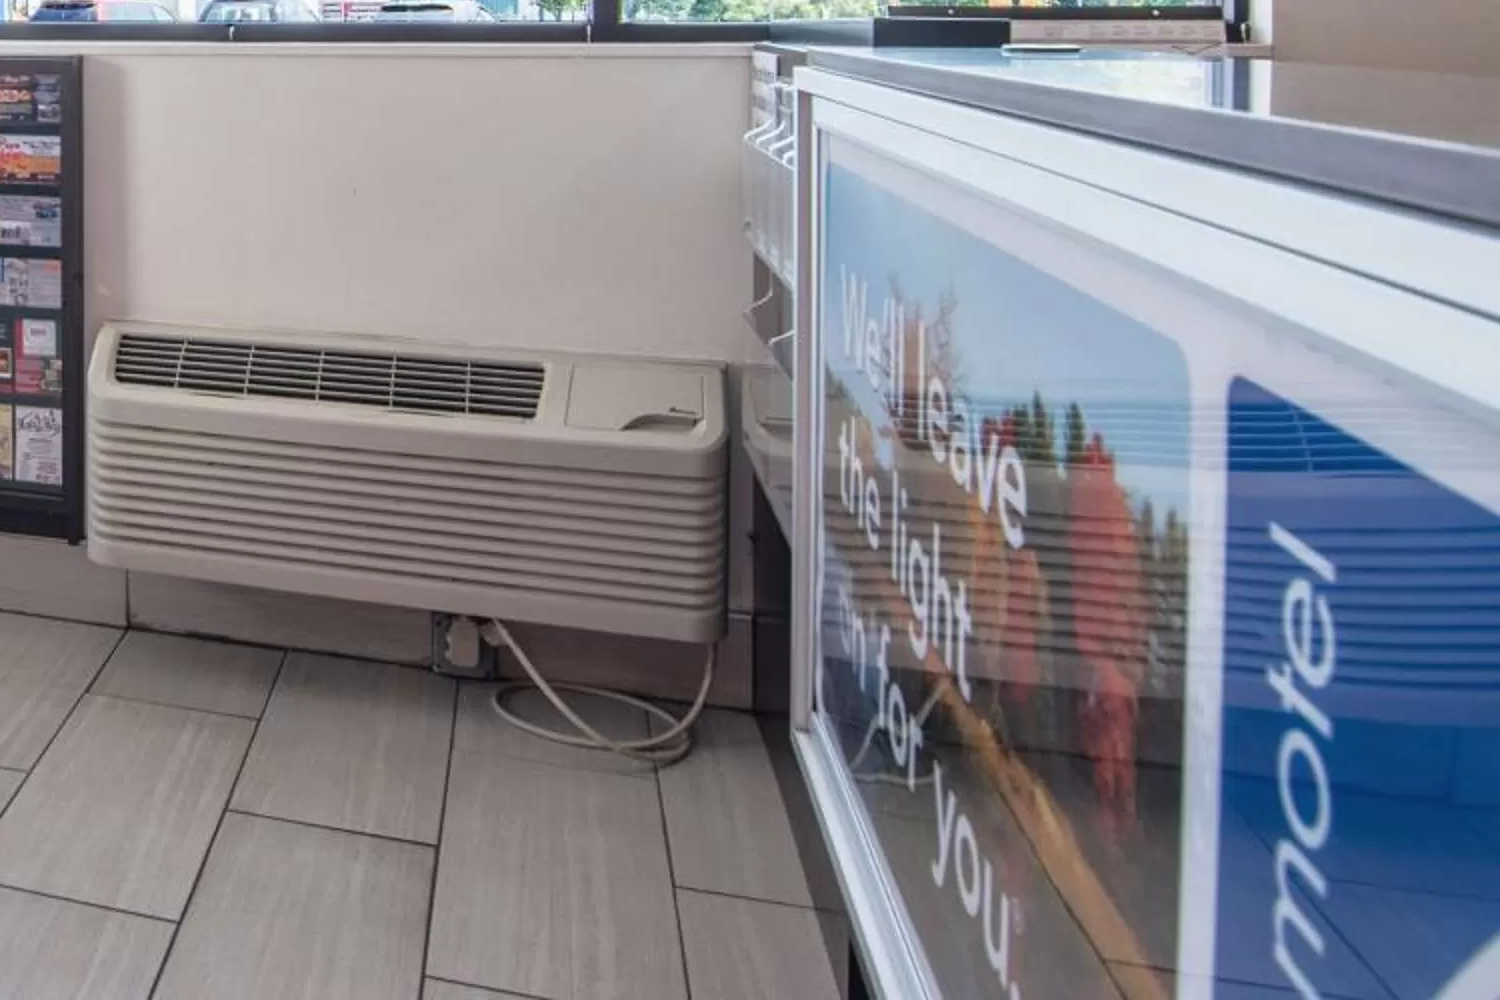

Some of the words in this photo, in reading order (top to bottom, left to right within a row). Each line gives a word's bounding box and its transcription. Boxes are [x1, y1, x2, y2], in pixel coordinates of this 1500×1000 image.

[918, 319, 1028, 550] leave
[838, 414, 882, 550] the
[891, 469, 972, 702] light
[876, 623, 924, 792] for
